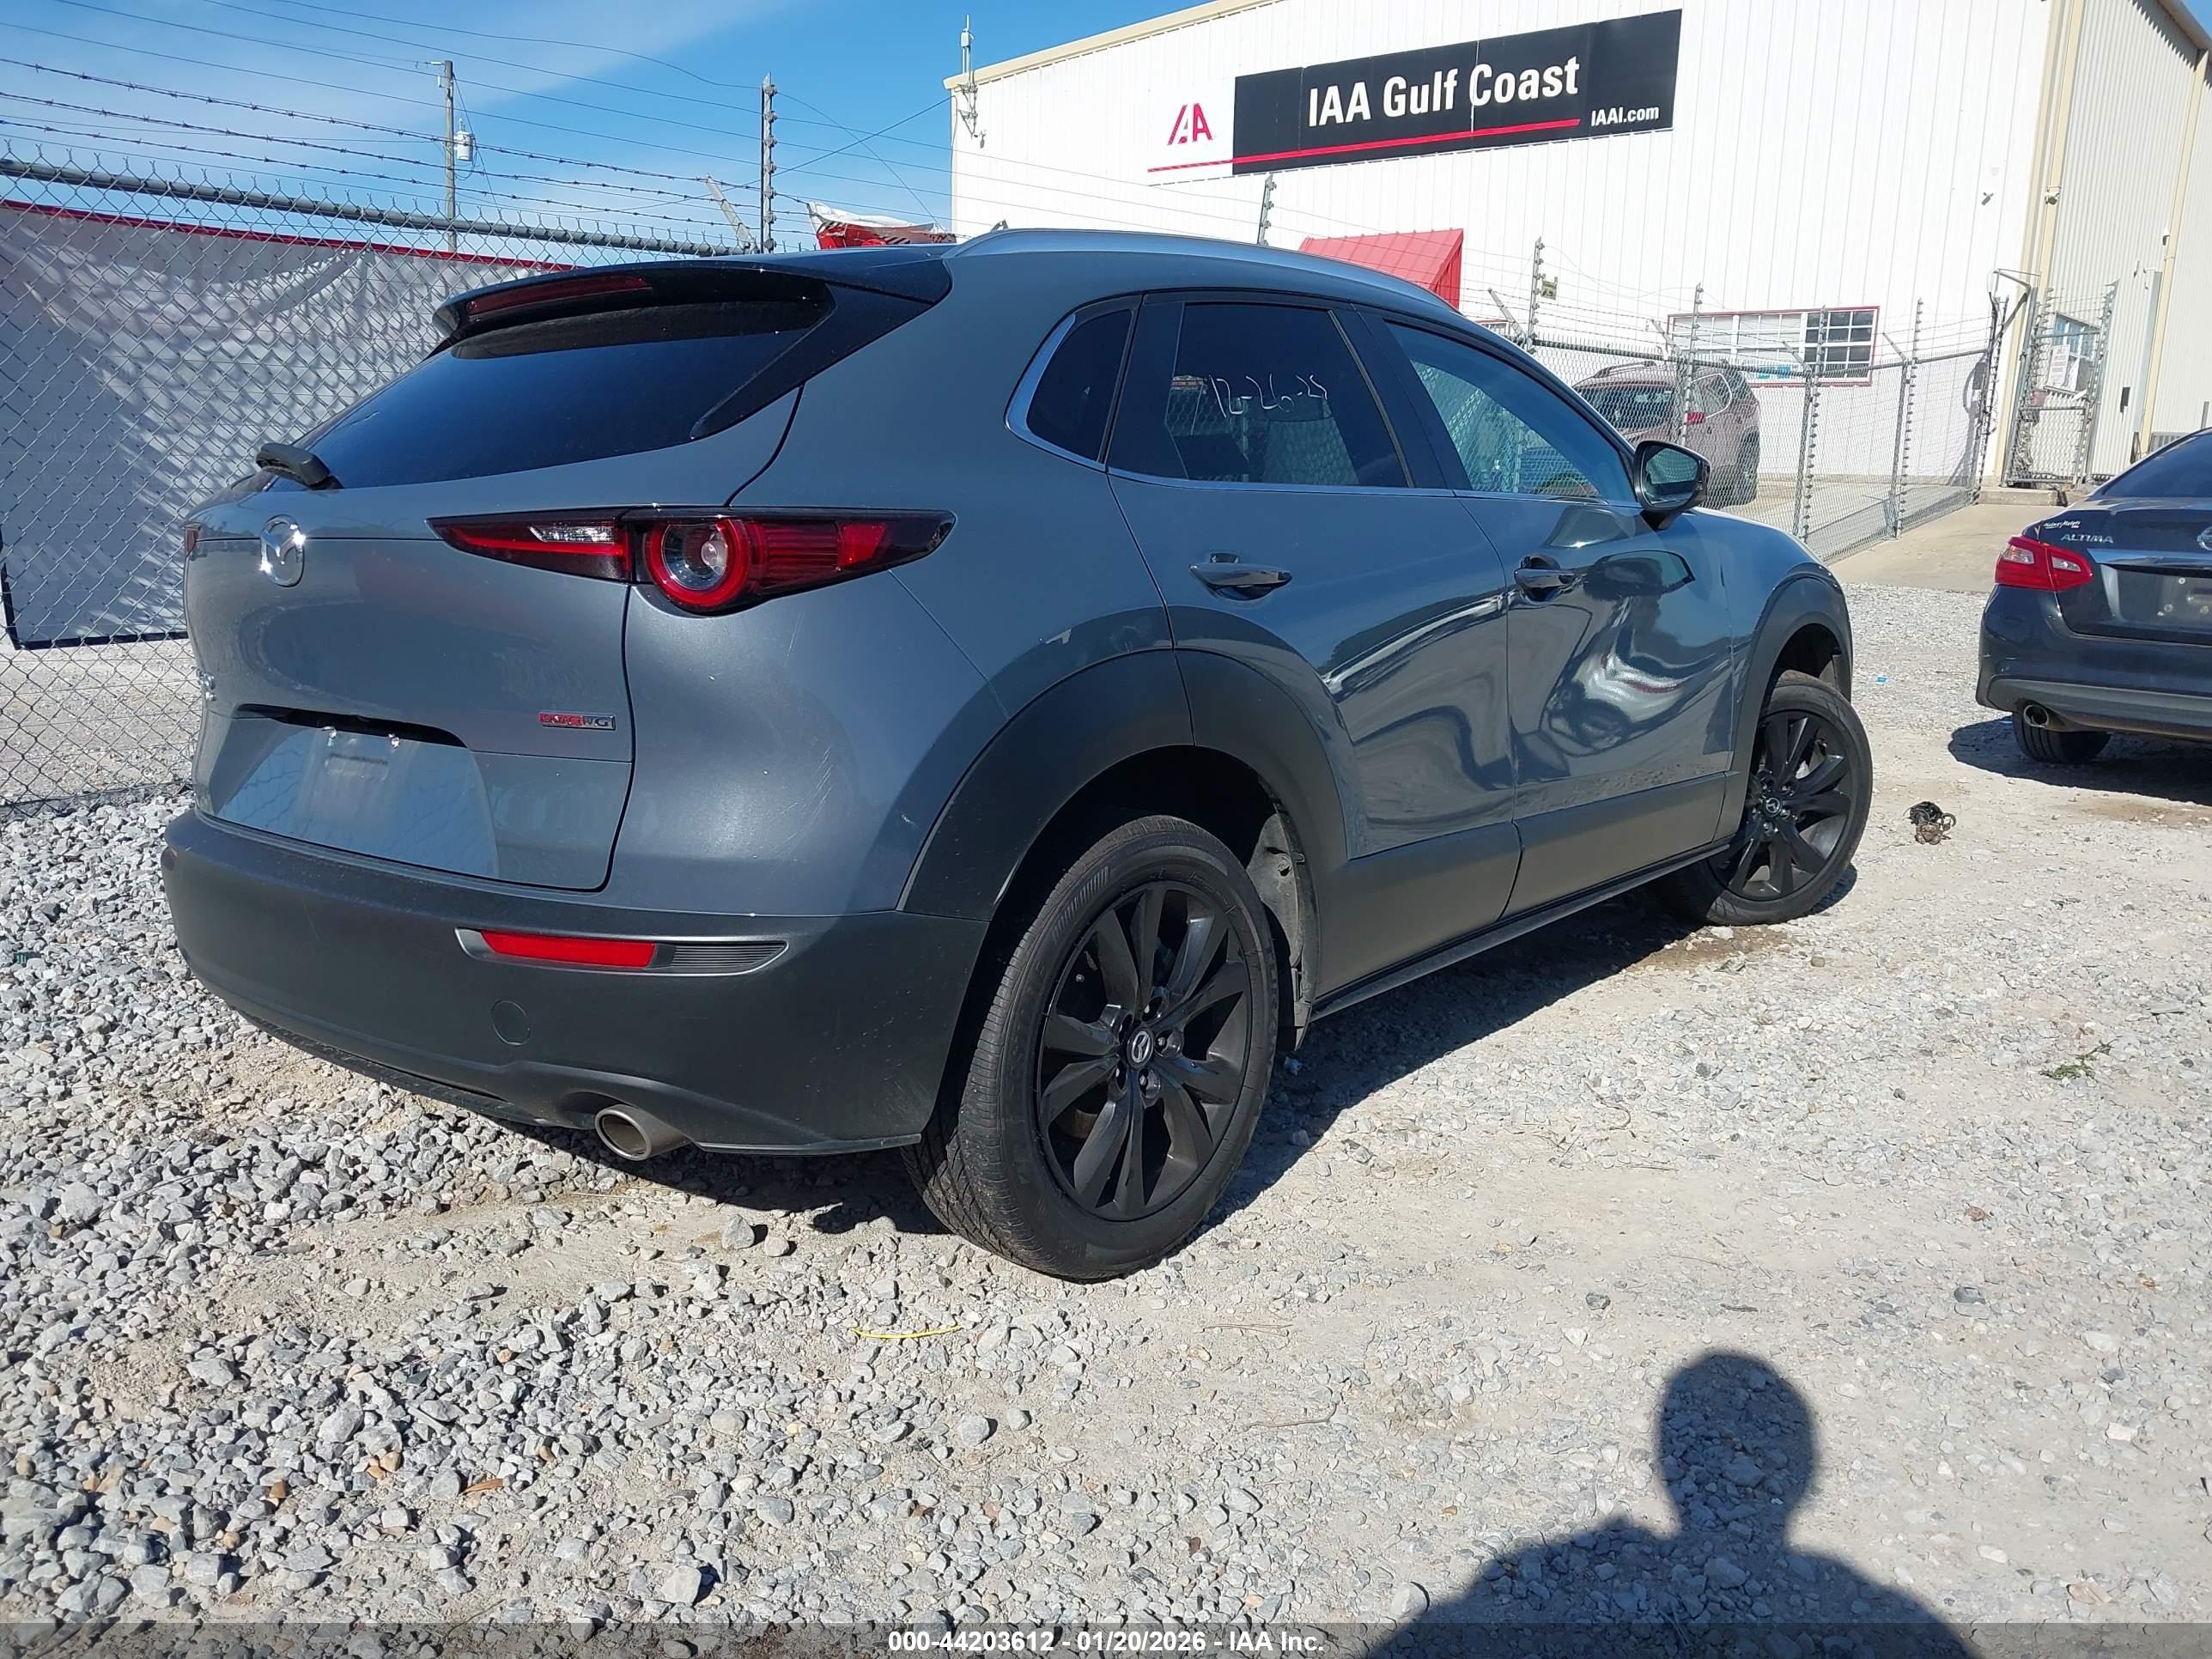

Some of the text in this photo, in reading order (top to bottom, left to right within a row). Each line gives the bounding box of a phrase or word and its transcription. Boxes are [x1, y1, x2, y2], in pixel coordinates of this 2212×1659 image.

[1309, 56, 1580, 127] IAA Gulf Coast
[1590, 104, 1661, 127] IAAI.com
[2061, 533, 2114, 544] ALTIMA
